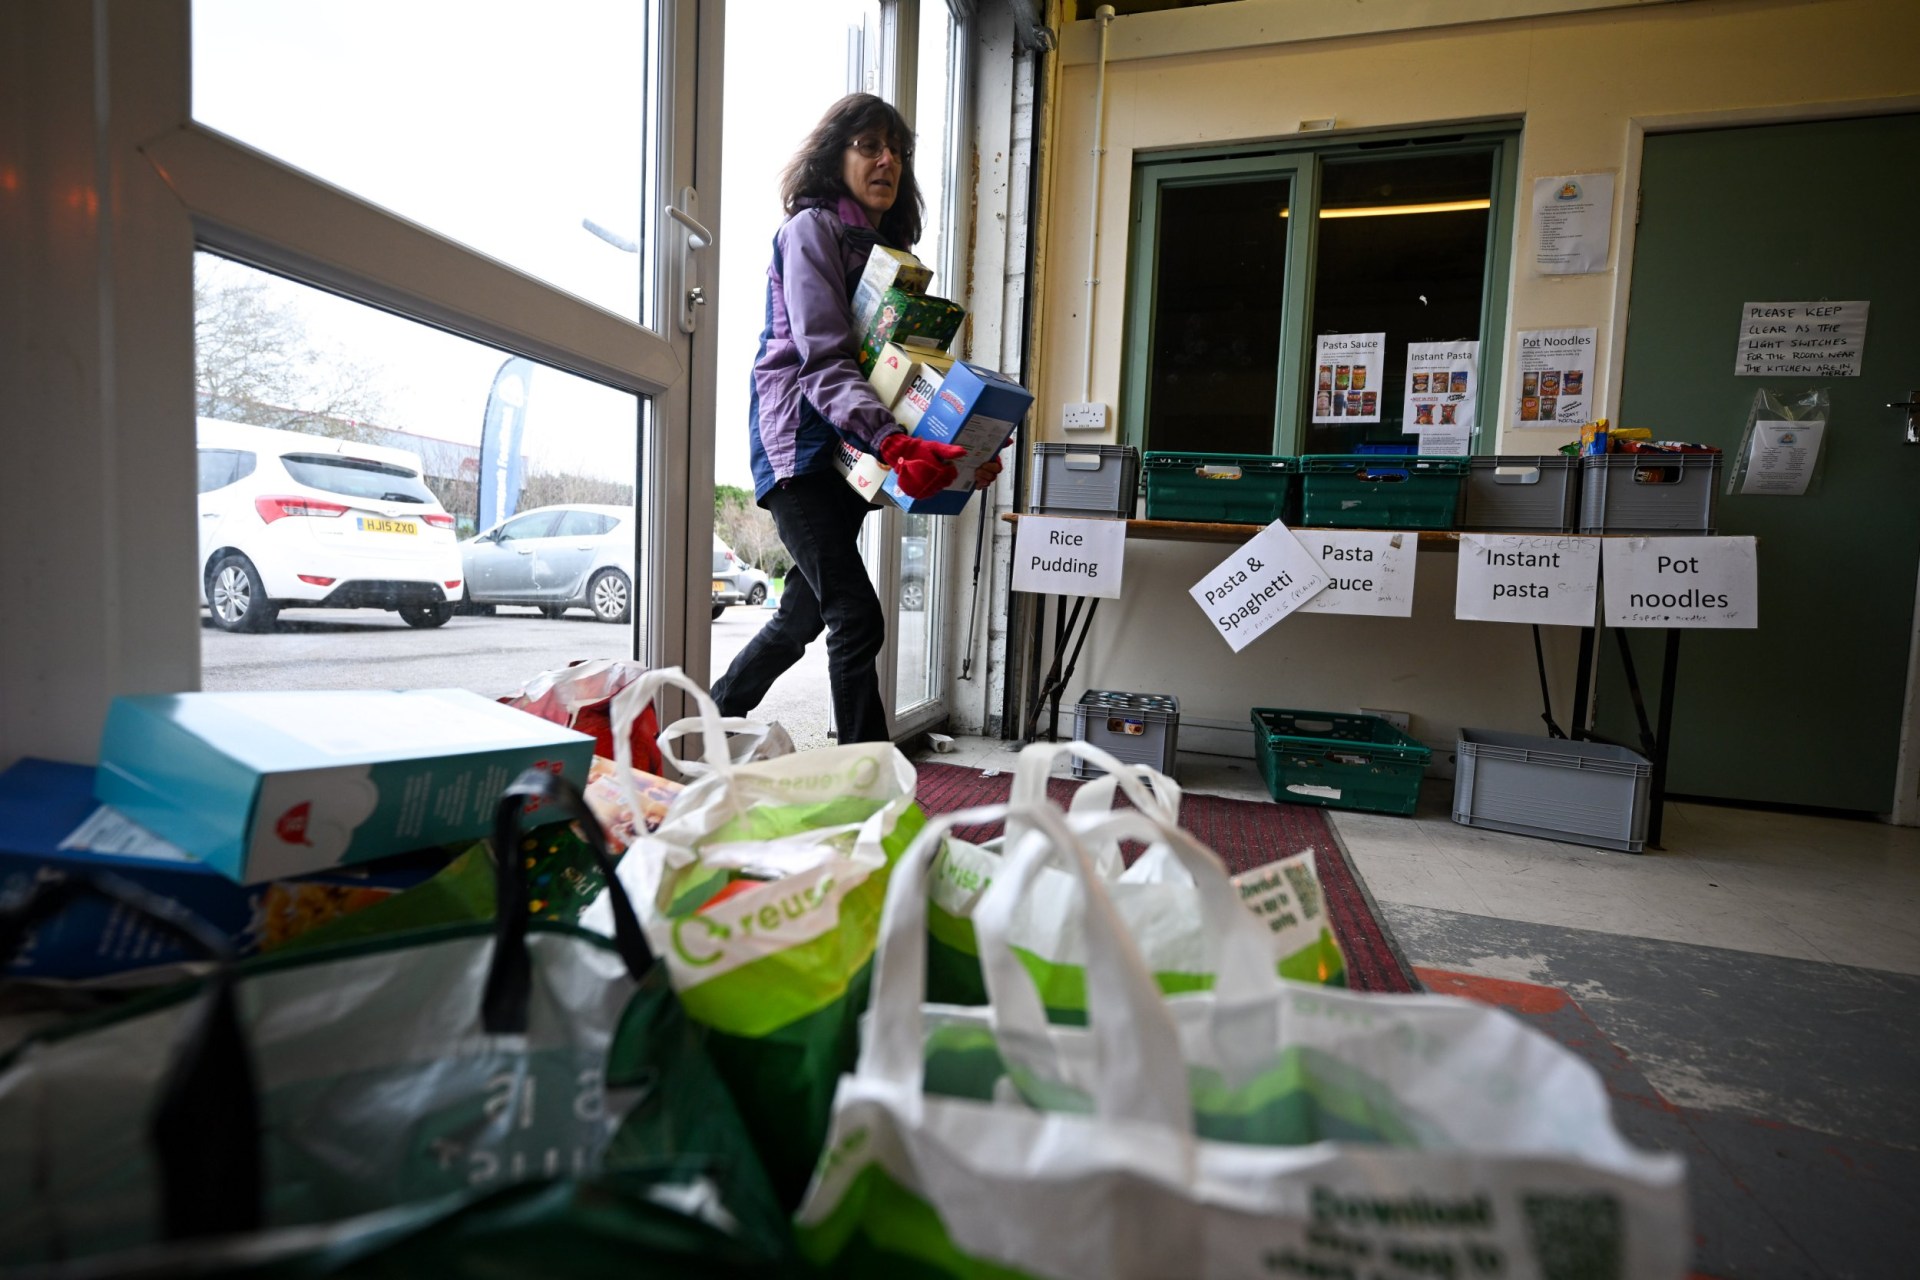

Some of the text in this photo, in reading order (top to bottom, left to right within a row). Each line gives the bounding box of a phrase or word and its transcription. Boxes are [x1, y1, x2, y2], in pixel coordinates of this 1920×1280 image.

[1751, 306, 1843, 318] PLEASE KEEP
[1749, 324, 1841, 335] CLEAR AS THE
[1322, 340, 1378, 350] Pasta Sauce
[1522, 336, 1591, 347] Pot Noodles
[1748, 338, 1848, 349] LIGHT SWITCHES
[1411, 351, 1473, 361] Instant Pasta
[1747, 352, 1764, 361] FOR
[1766, 352, 1786, 360] THE
[1792, 351, 1824, 359] ROOMS
[1744, 364, 1761, 373] THE
[1767, 364, 1811, 372] KITCHEN
[911, 374, 936, 401] CORN
[905, 386, 930, 413] FLAKES
[367, 520, 392, 531] HJ15
[1049, 530, 1083, 546] Rice
[1322, 545, 1374, 562] Pasta
[1486, 549, 1561, 568] Instant
[1031, 556, 1098, 578] Pudding
[1658, 556, 1699, 574] Pot
[1205, 557, 1265, 605] Pasta &
[1328, 577, 1373, 592] auce
[1492, 583, 1550, 601] pasta
[1630, 589, 1729, 608] noodles
[1218, 570, 1294, 632] Spaghetti
